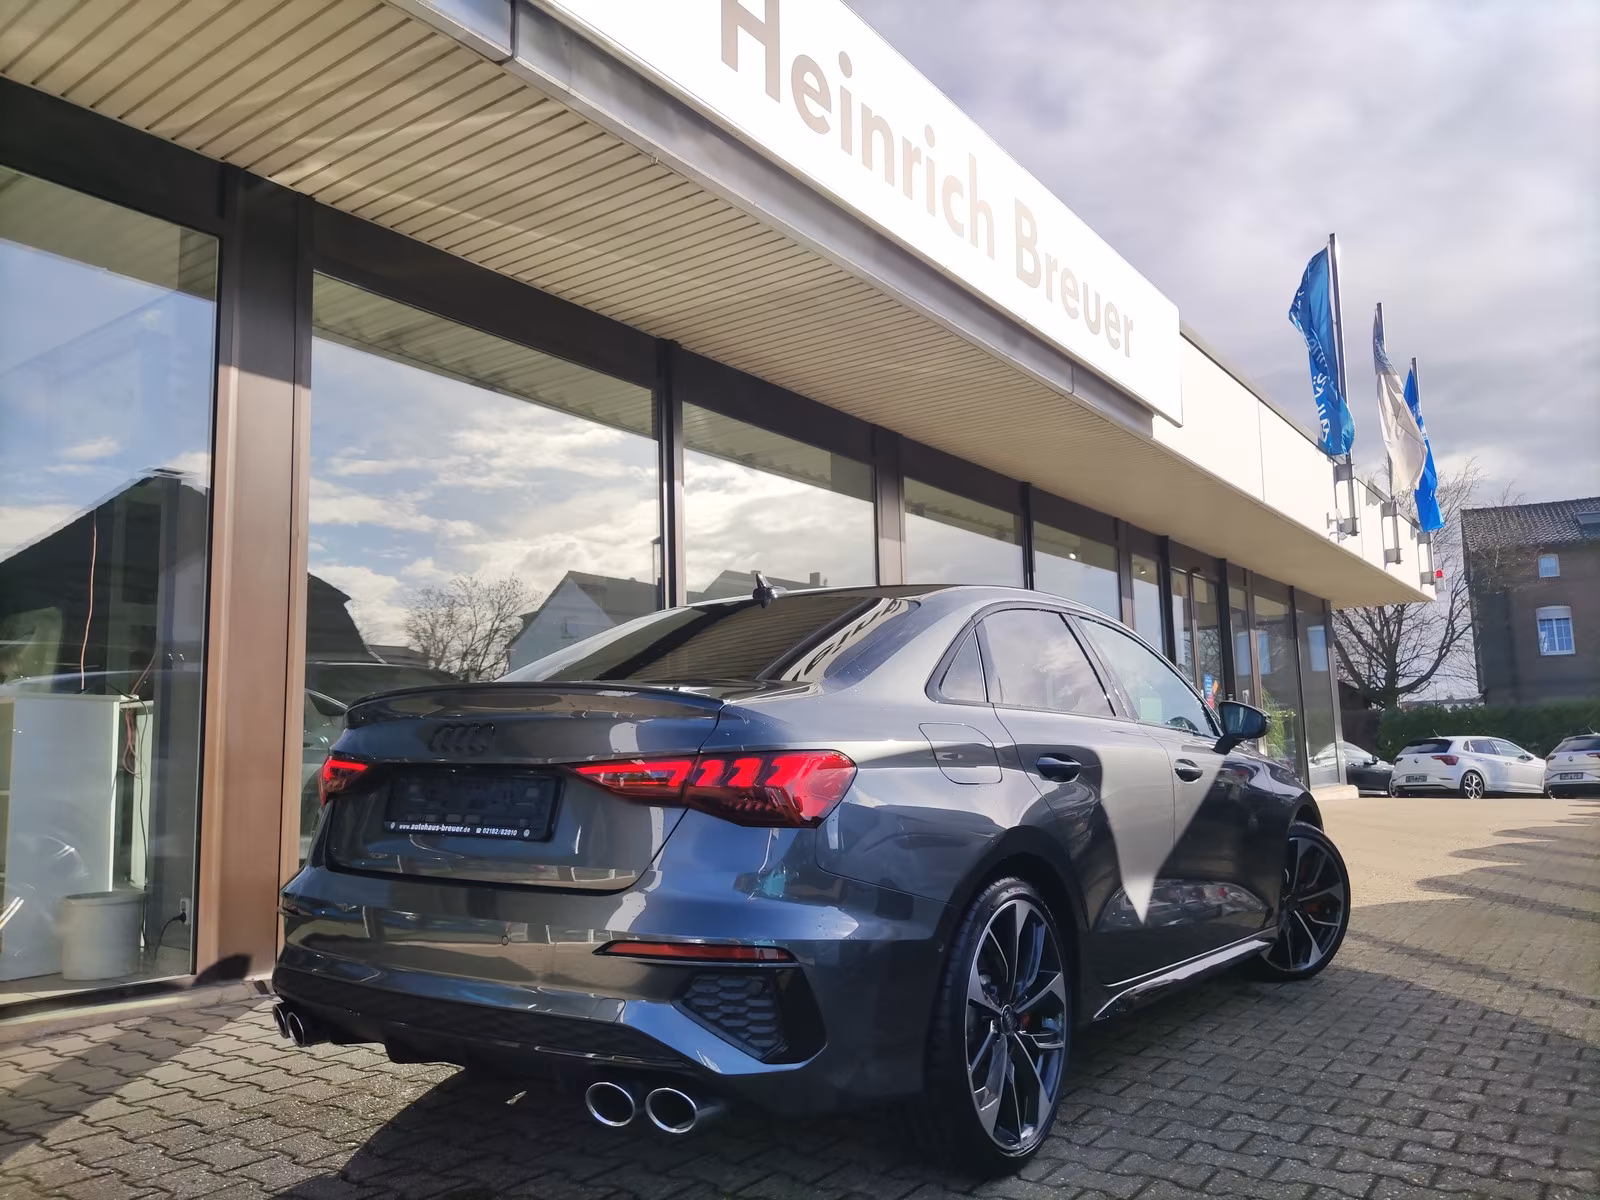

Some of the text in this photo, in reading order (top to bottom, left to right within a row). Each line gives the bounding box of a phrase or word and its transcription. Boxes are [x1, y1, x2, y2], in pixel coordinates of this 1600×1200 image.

[721, 0, 1134, 358] Heinrich Breuer
[399, 823, 471, 833] www.autohaus-breuer.de
